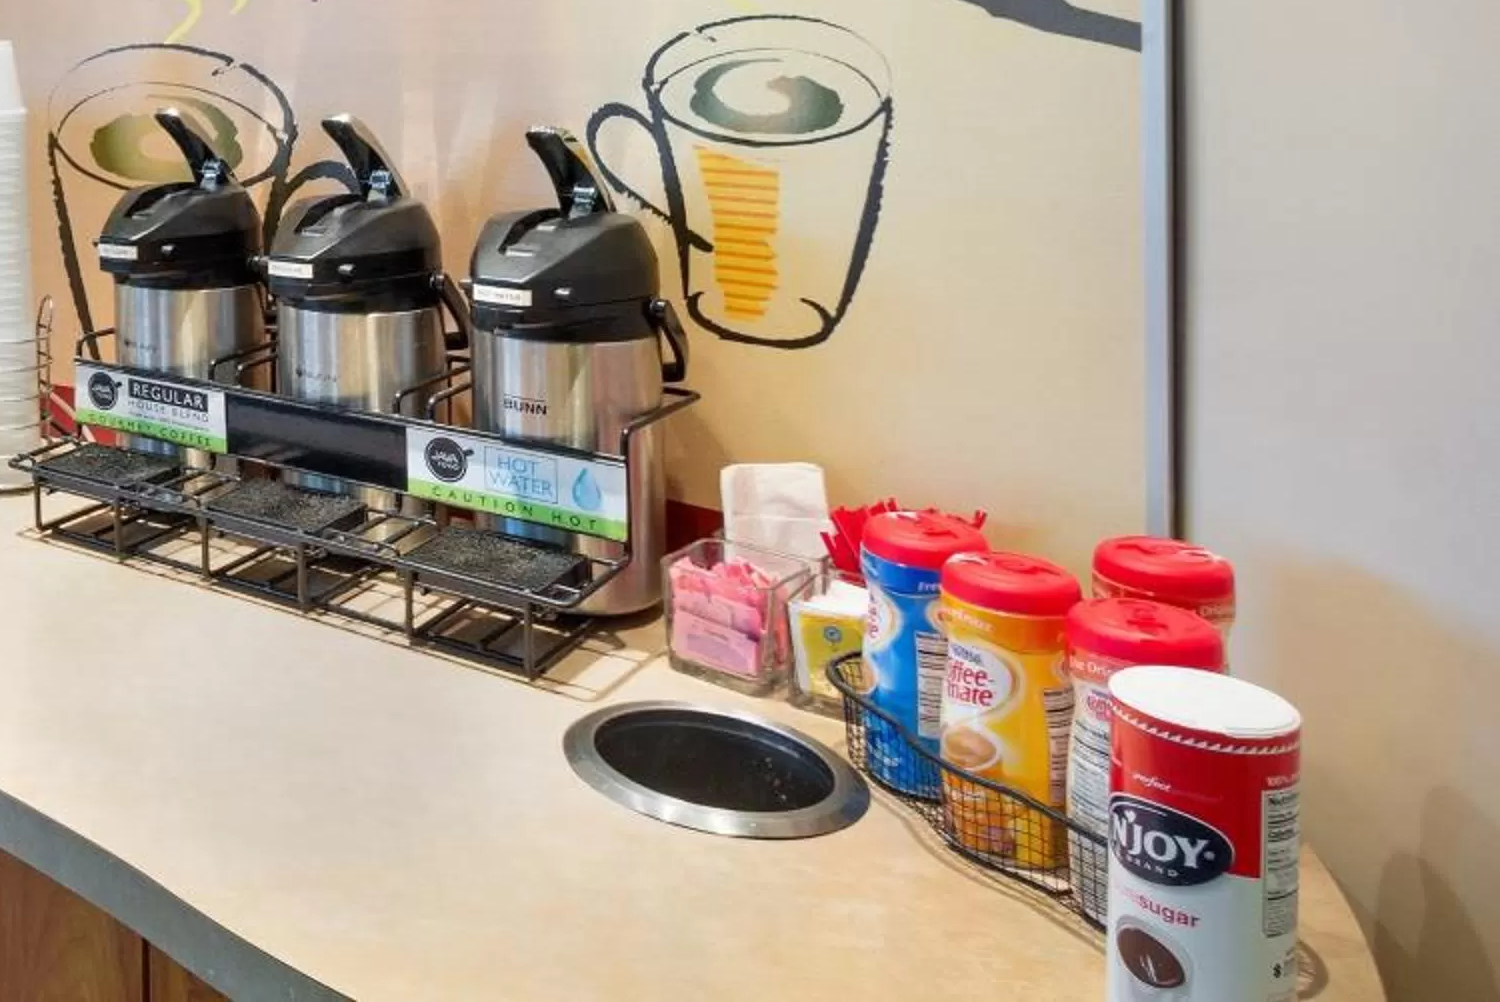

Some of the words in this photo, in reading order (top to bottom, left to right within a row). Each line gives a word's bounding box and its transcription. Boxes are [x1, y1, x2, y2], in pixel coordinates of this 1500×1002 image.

[131, 382, 204, 410] REGULAR
[503, 398, 547, 416] BUNN
[496, 455, 542, 473] HOT
[488, 470, 552, 496] WATER
[431, 485, 533, 517] CAUTION
[551, 510, 598, 530] HOT
[1138, 894, 1201, 928] sugar
